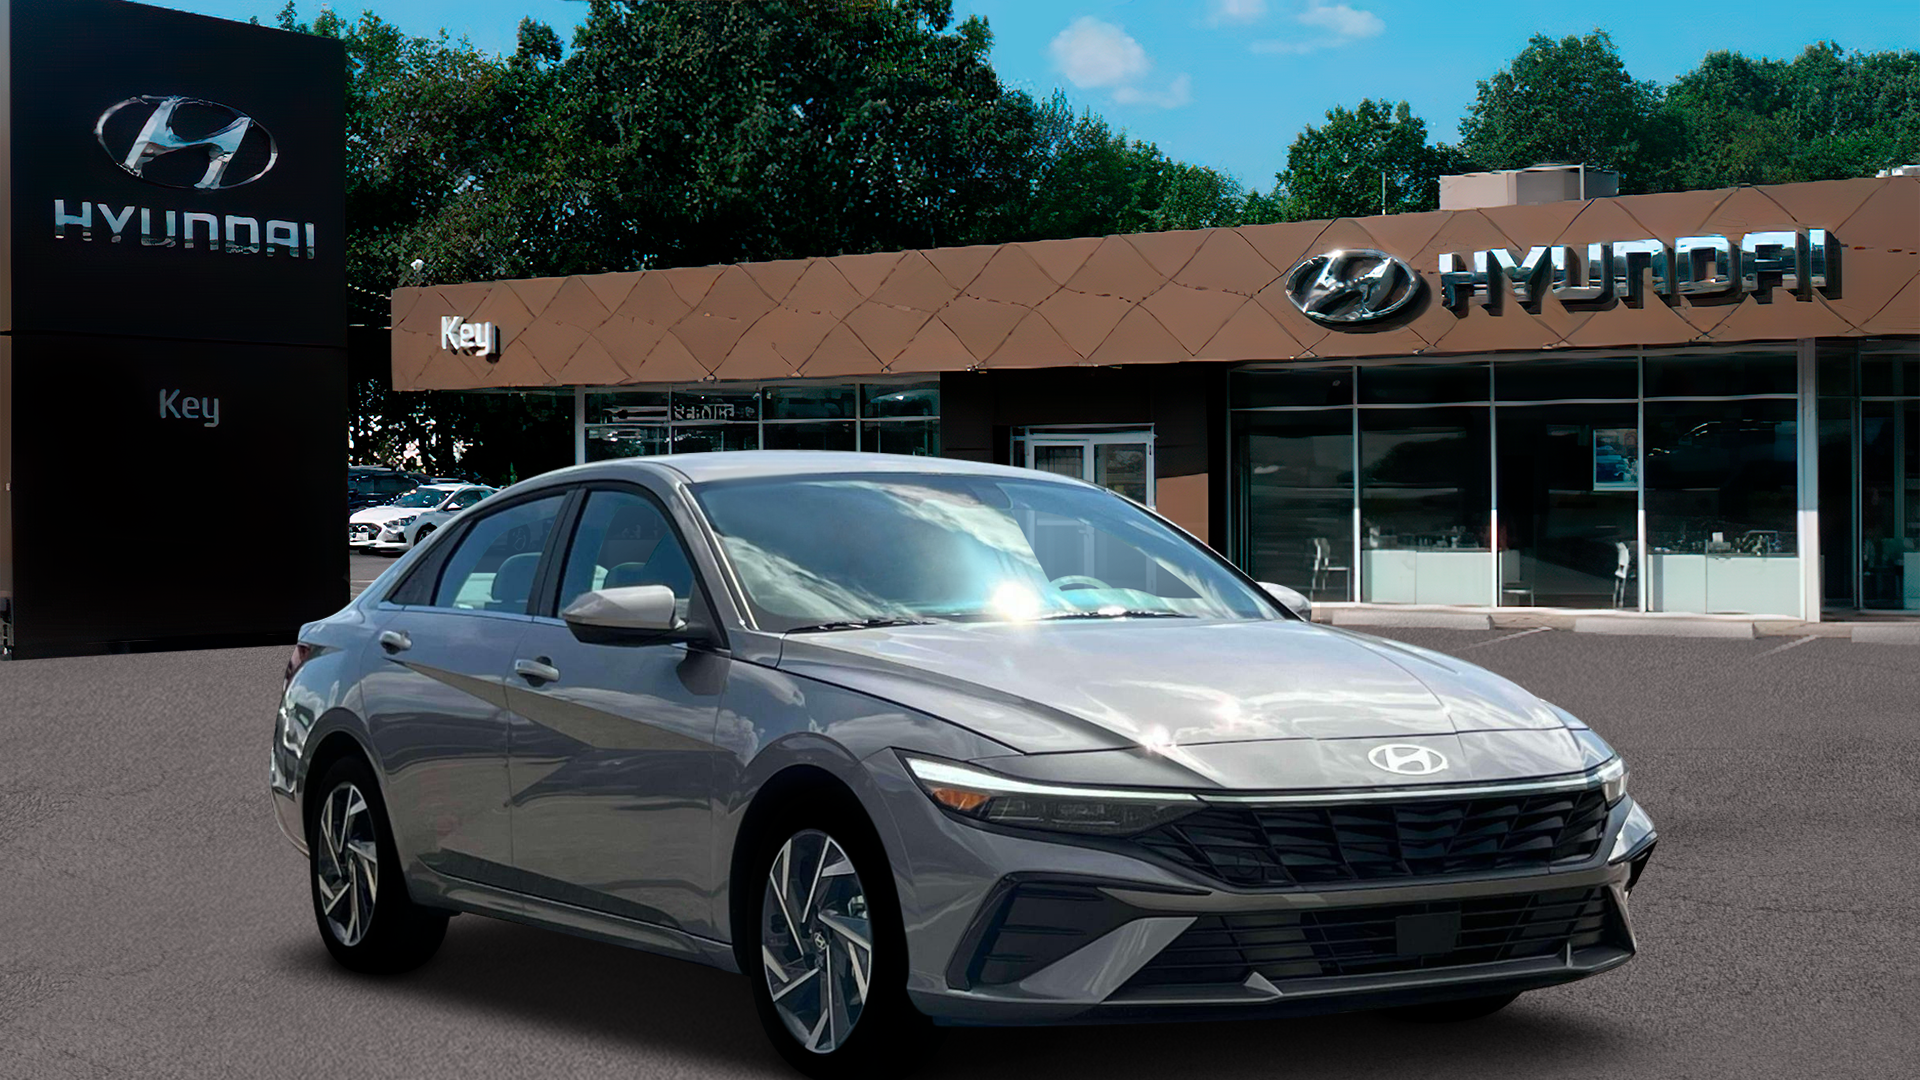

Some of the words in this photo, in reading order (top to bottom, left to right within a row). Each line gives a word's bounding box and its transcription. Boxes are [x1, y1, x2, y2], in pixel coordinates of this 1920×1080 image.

[54, 199, 315, 260] HYUNDAI
[1438, 229, 1838, 314] HYUNDAI
[440, 315, 494, 357] Key
[159, 387, 220, 428] Key
